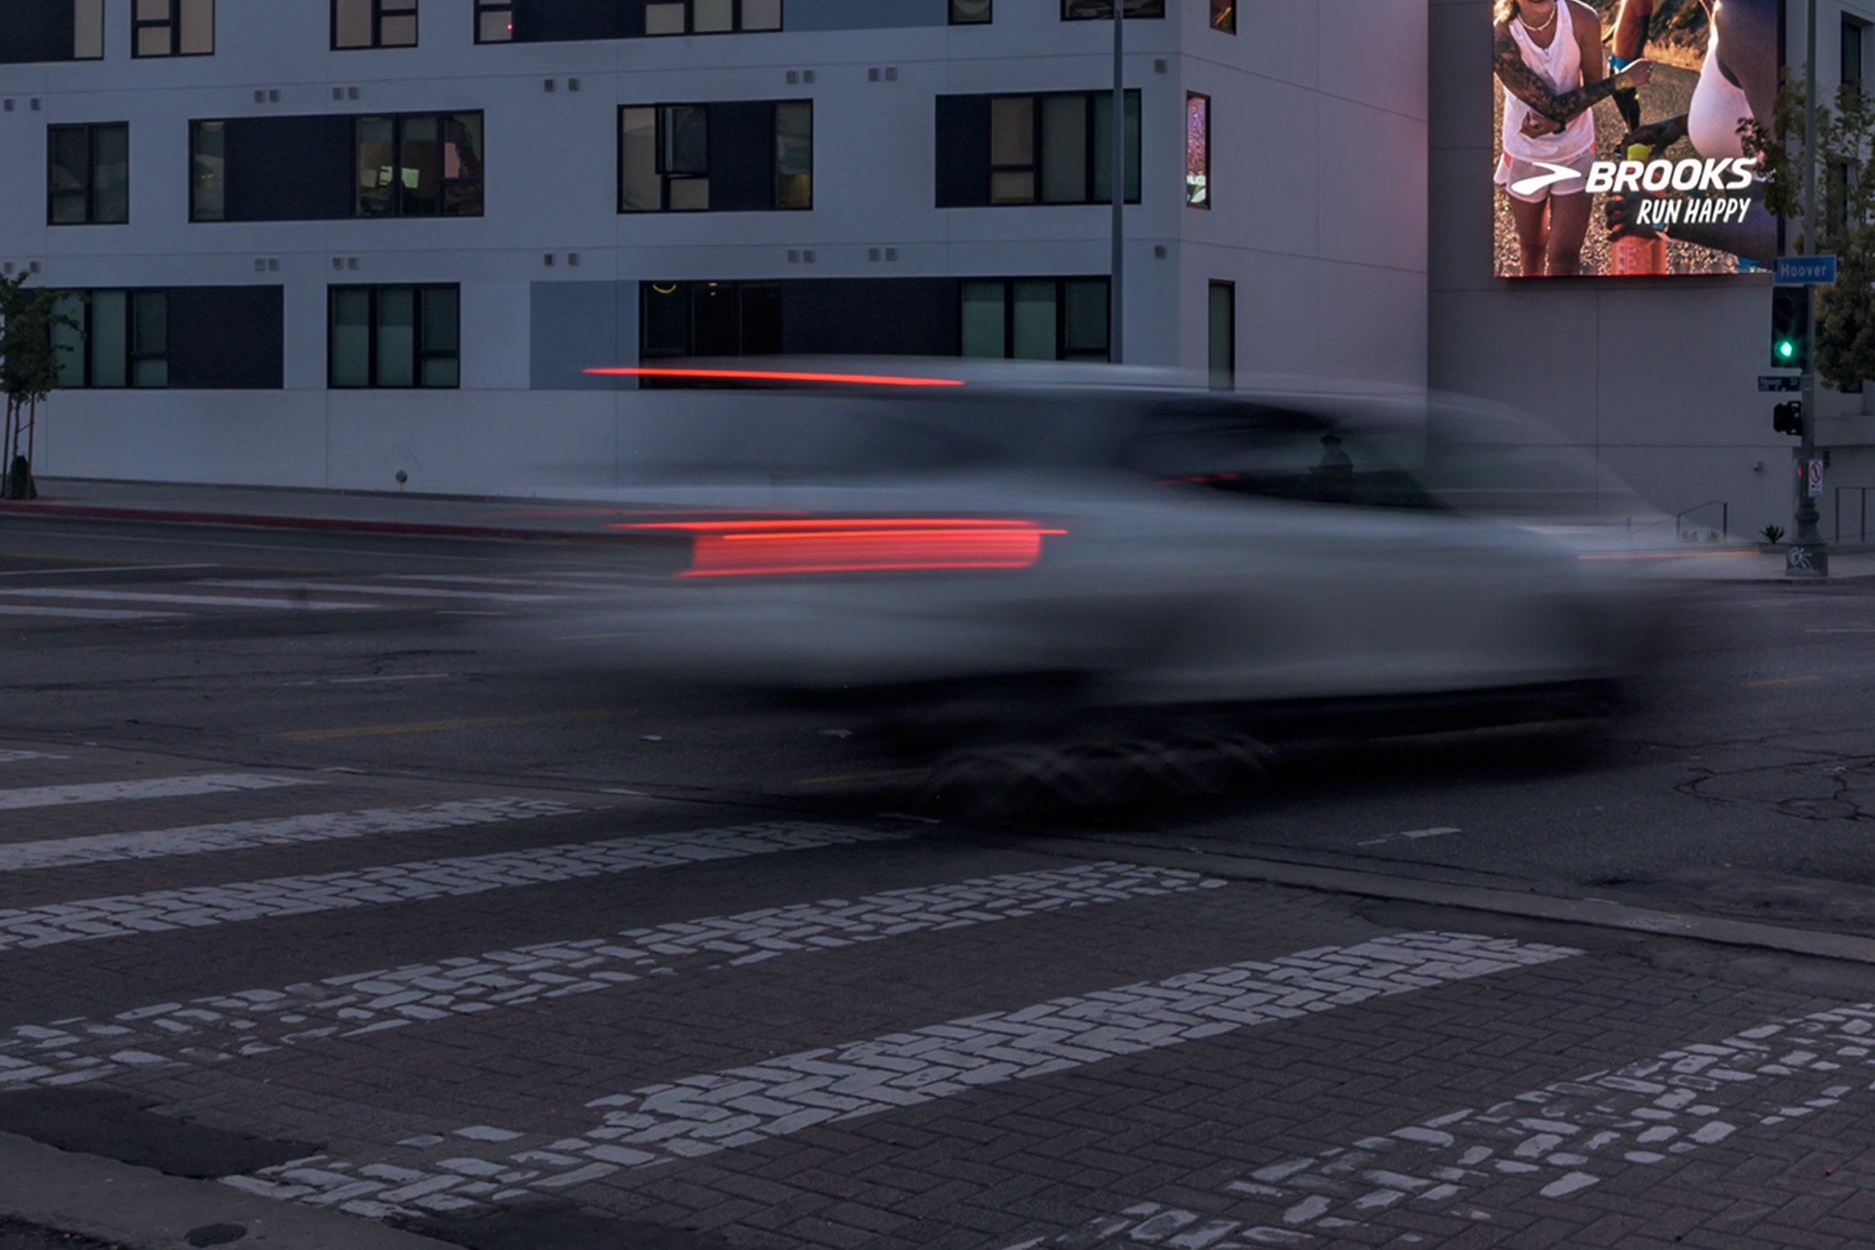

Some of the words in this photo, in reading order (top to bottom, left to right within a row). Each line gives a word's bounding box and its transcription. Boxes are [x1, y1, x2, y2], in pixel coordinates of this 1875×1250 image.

[1585, 157, 1758, 194] BROOKS
[1636, 198, 1682, 225] RUN
[1683, 197, 1752, 225] HAPPY
[1780, 263, 1829, 278] Hoover
